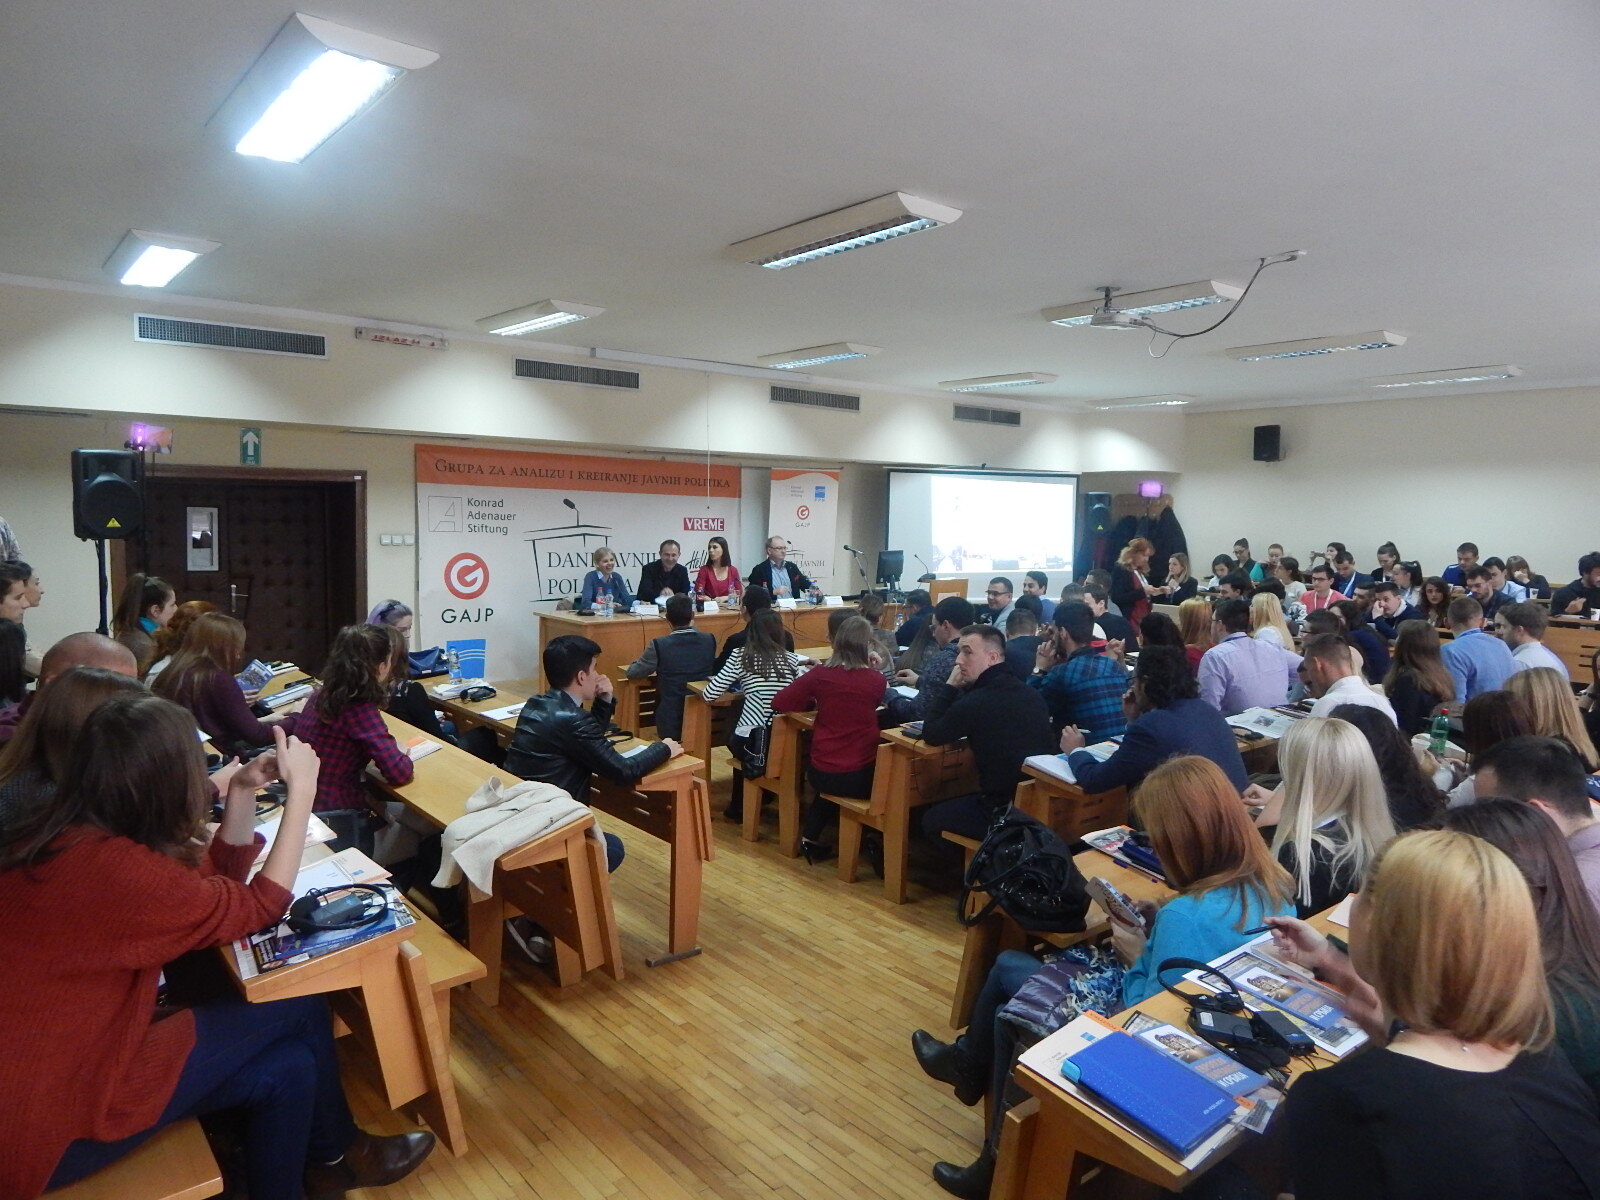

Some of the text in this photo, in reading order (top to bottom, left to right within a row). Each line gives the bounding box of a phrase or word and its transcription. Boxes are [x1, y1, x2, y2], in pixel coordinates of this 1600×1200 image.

[435, 458, 484, 475] GRUPA
[488, 466, 506, 475] ZA
[510, 466, 565, 479] ANALIZU
[577, 470, 638, 485] KREIRANJE
[641, 475, 681, 486] JAVNIH
[684, 477, 730, 488] POLITIKA
[467, 497, 504, 508] Konrad
[467, 510, 516, 521] Adenauer
[467, 523, 508, 536] Stiftung
[685, 518, 724, 531] VREME
[547, 552, 595, 568] DANI
[441, 607, 494, 624] GAJP
